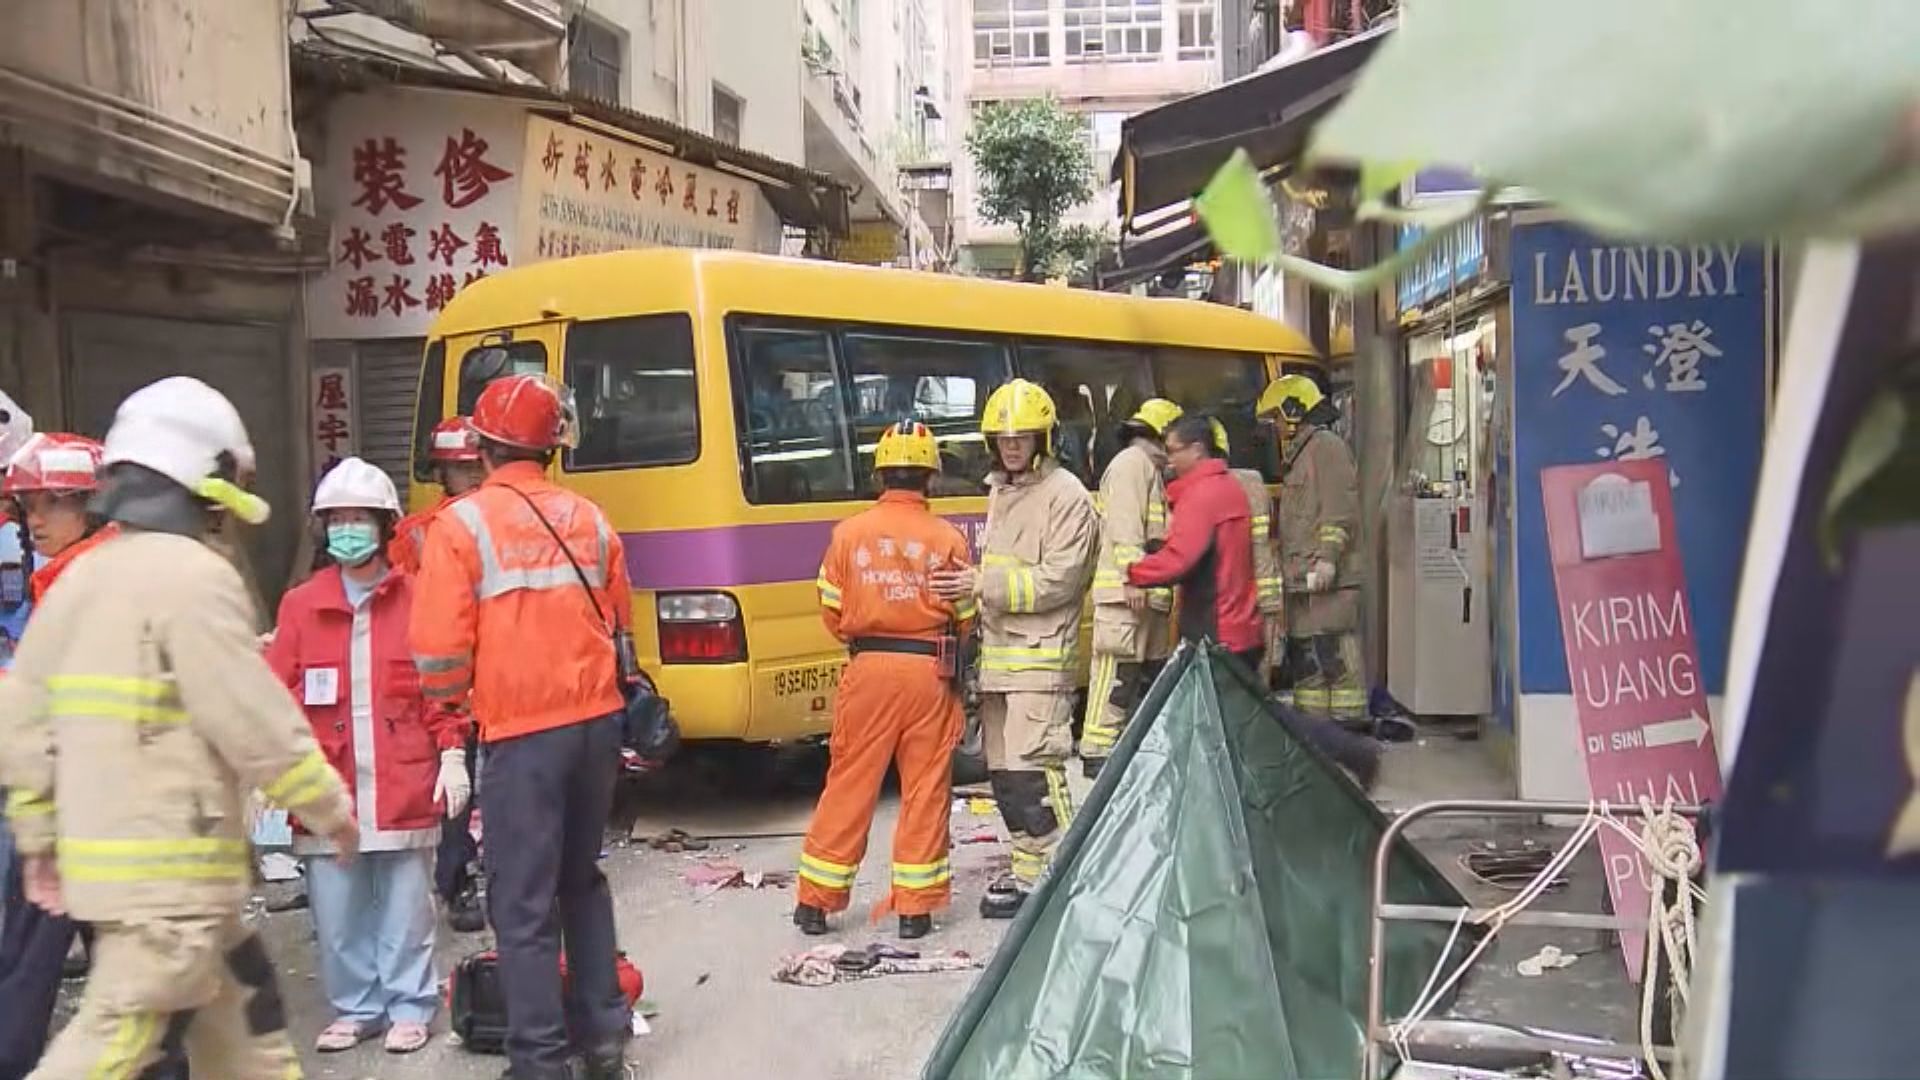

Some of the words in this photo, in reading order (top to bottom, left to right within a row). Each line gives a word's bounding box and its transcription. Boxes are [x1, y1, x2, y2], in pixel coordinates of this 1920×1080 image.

[352, 128, 514, 216] 裝修
[1534, 242, 1741, 304] LAUNDRY
[316, 373, 350, 476] 屋宇
[1572, 589, 1688, 650] KIRIM
[774, 672, 786, 697] 19
[787, 666, 818, 694] SEATS
[1583, 653, 1696, 708] UANG
[1587, 735, 1605, 754] DI
[1611, 729, 1644, 750] SINI
